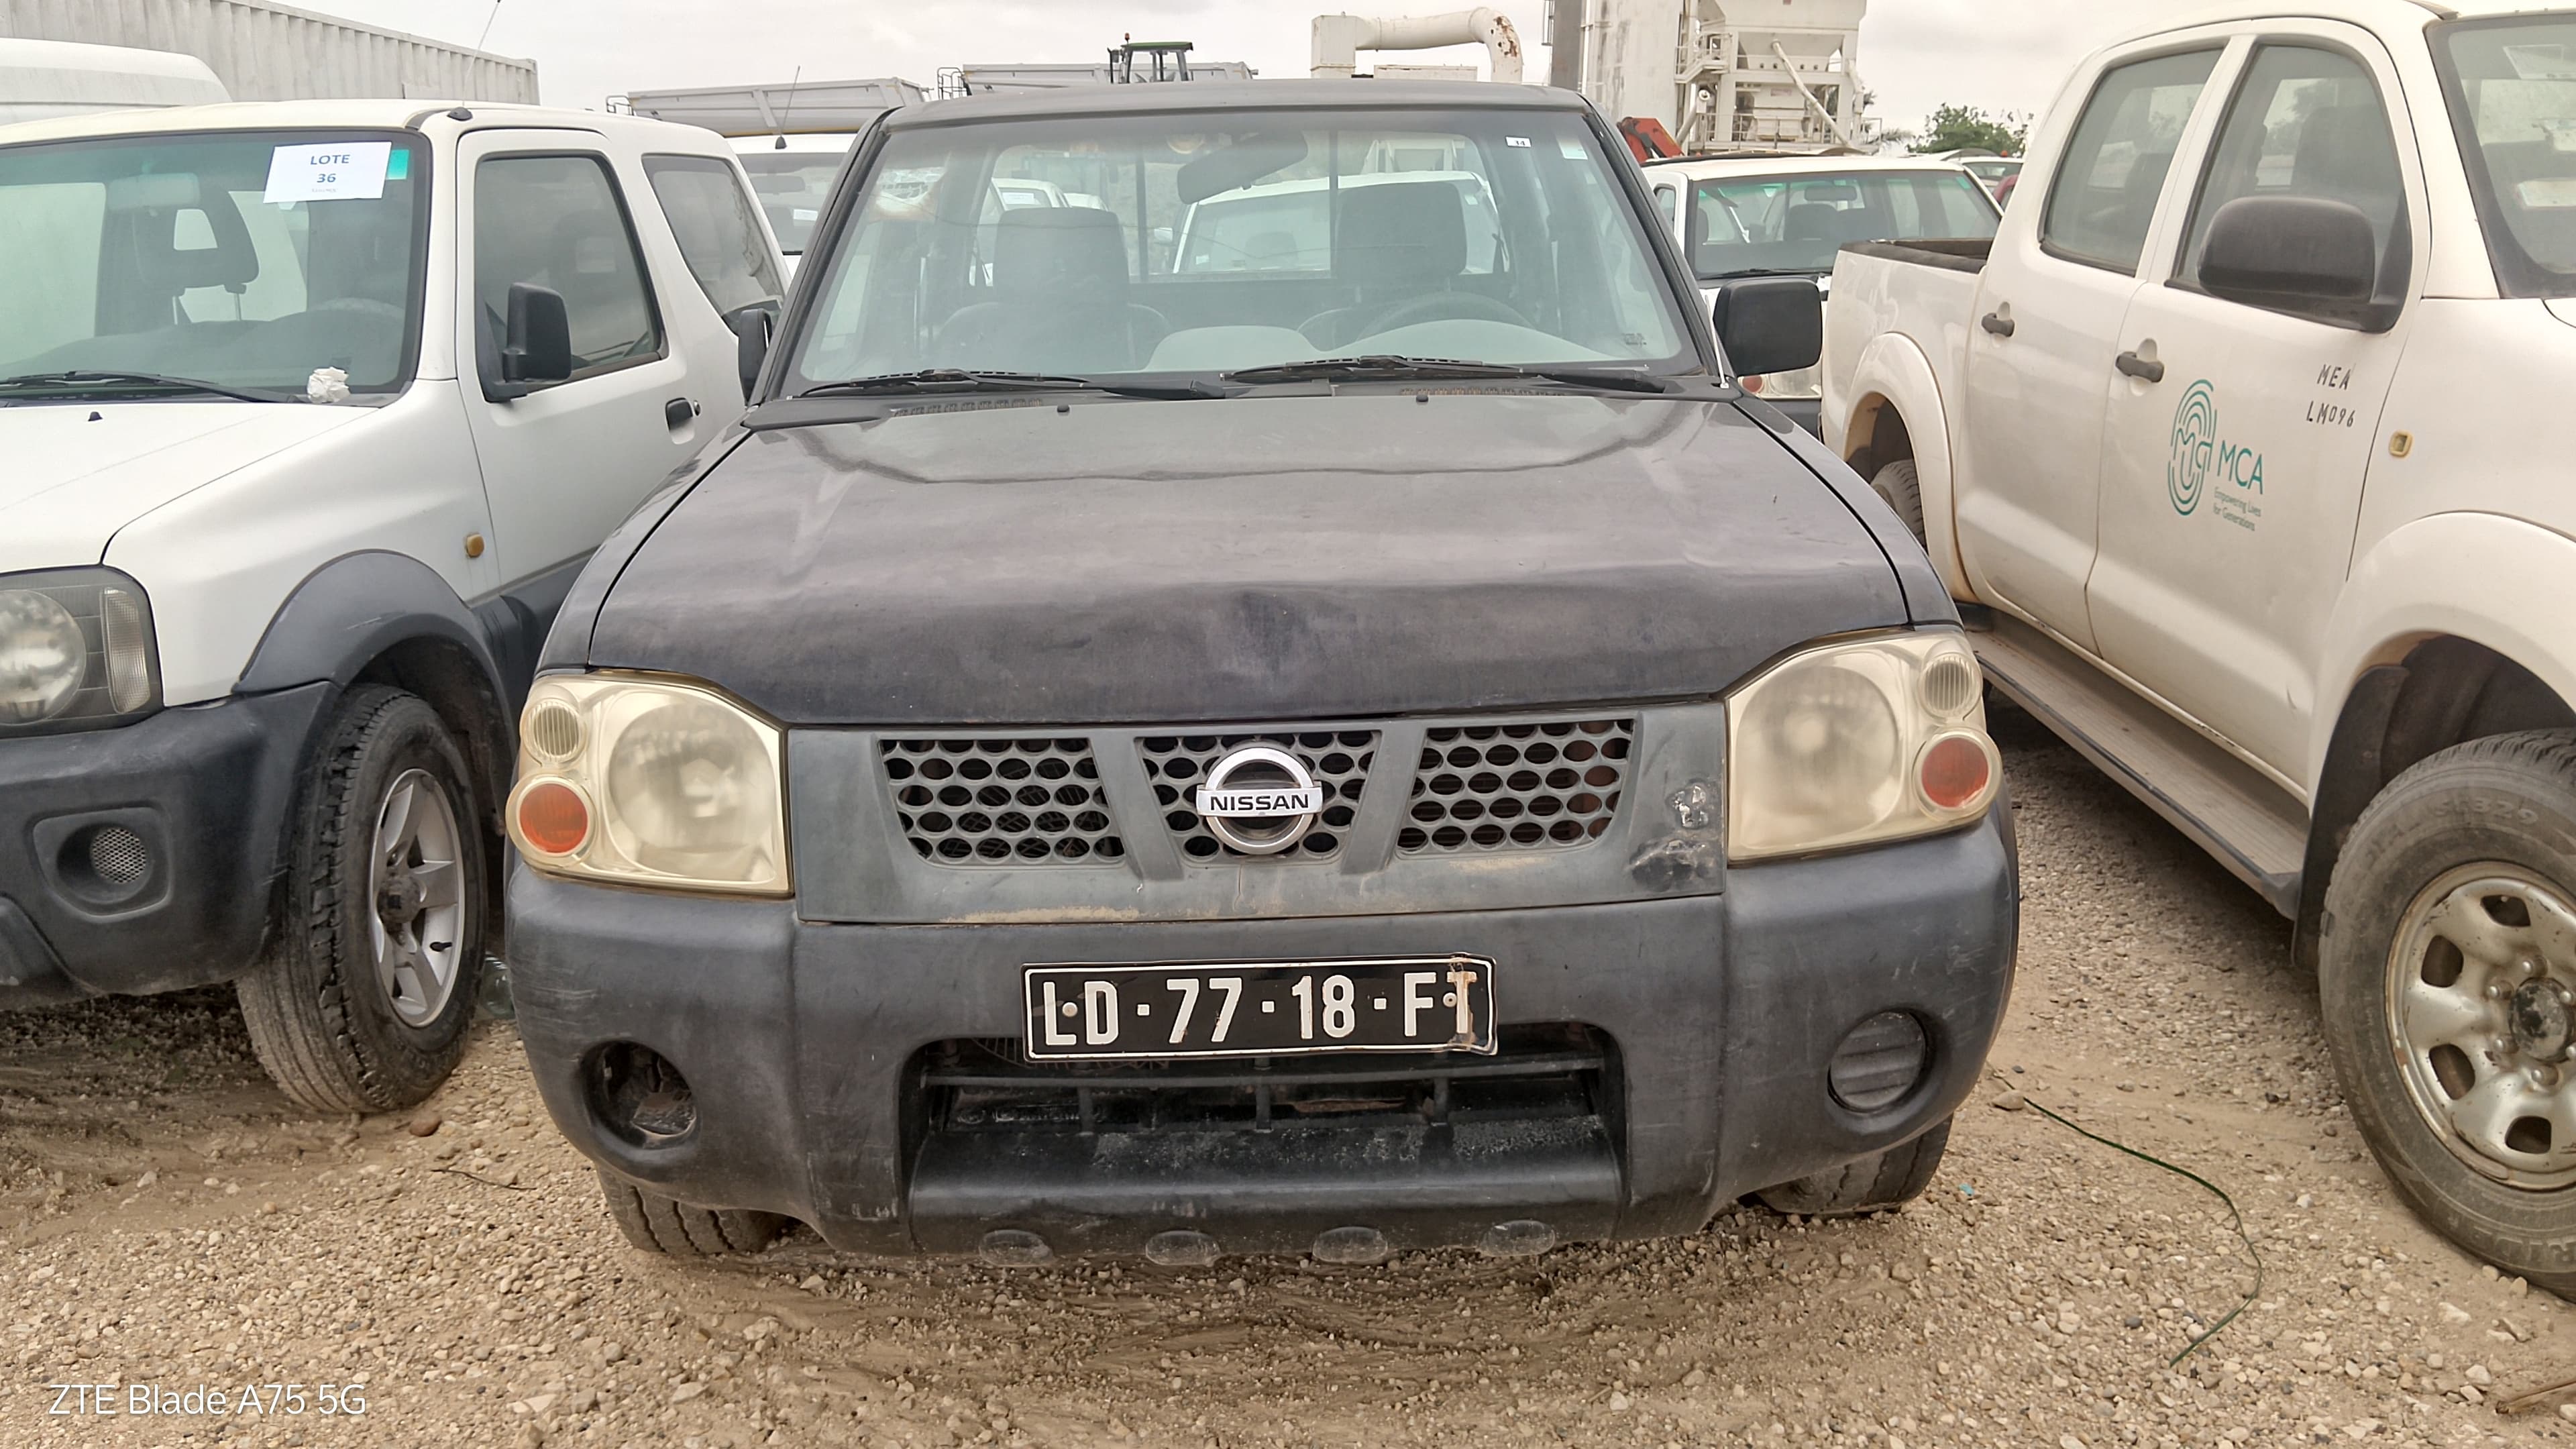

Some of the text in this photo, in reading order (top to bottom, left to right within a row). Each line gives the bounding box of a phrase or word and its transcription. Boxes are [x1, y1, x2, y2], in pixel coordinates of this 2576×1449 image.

[310, 154, 350, 165] LOTE
[317, 173, 336, 183] 36
[2316, 364, 2351, 390] MEA
[2306, 400, 2356, 428] LM096
[2217, 439, 2263, 495] MCA
[1210, 793, 1309, 811] NISSAN
